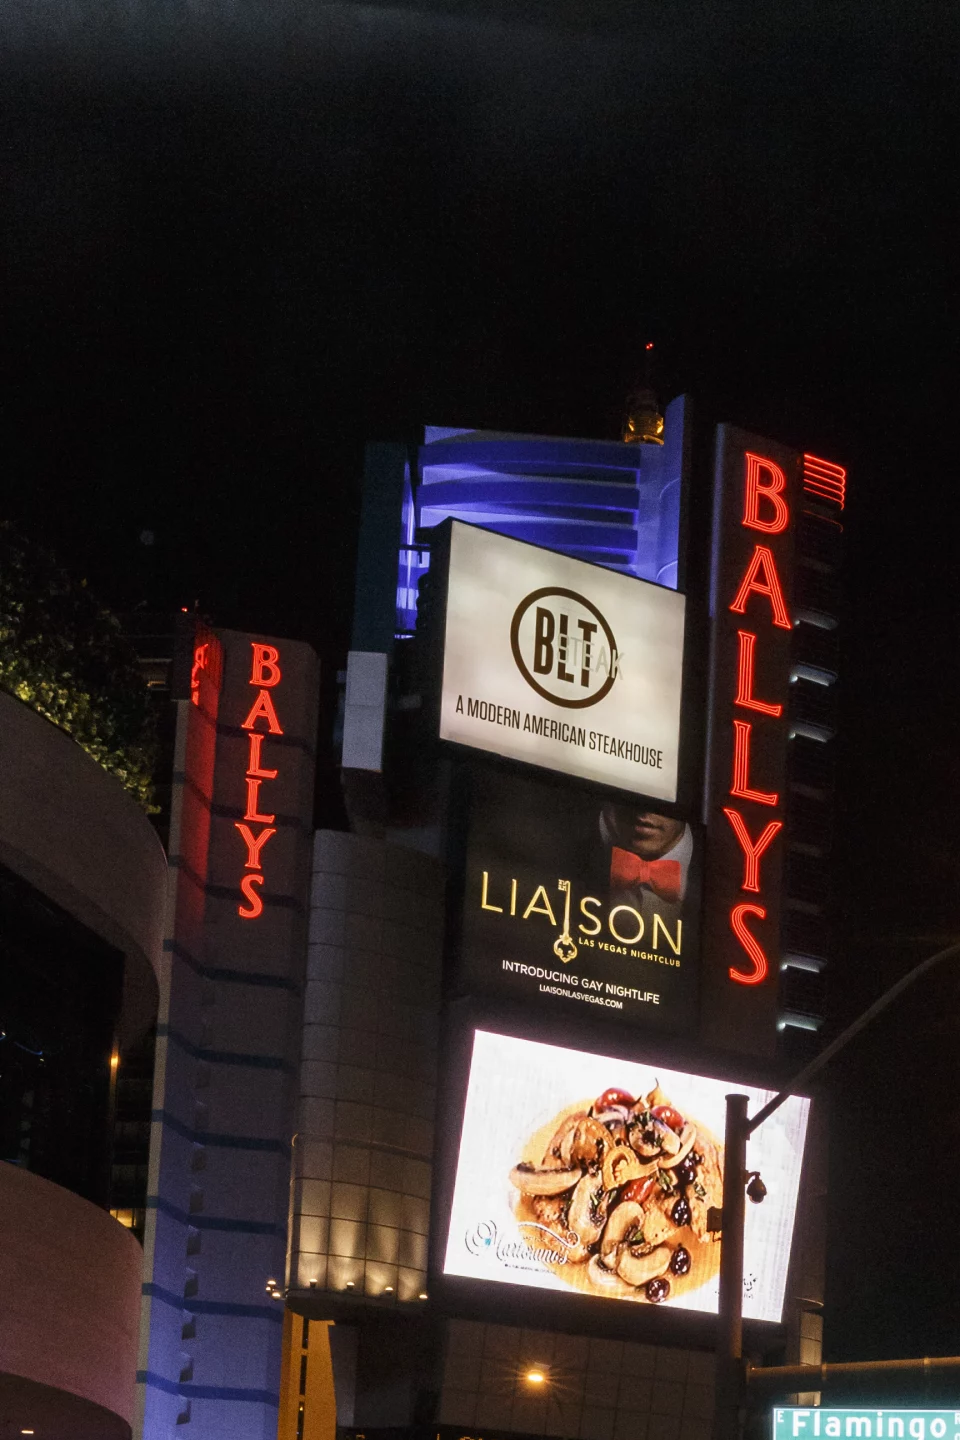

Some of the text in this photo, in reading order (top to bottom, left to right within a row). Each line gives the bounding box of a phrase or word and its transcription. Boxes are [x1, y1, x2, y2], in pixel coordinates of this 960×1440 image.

[533, 606, 598, 688] BLT
[557, 632, 625, 681] STEAK
[455, 695, 664, 769] A MODERN AMERICAN STEAKHOUSE
[723, 451, 791, 985] BALLYS
[234, 642, 284, 919] BALLYS
[481, 871, 683, 964] LIAISON
[502, 959, 660, 1005] INTRODUCING GAY NIGHTLIFE
[578, 936, 681, 967] LAS VEGAS NIGHTCLUB
[539, 984, 623, 1010] LIAISONLASVEGAS.COM
[776, 1410, 785, 1423] E
